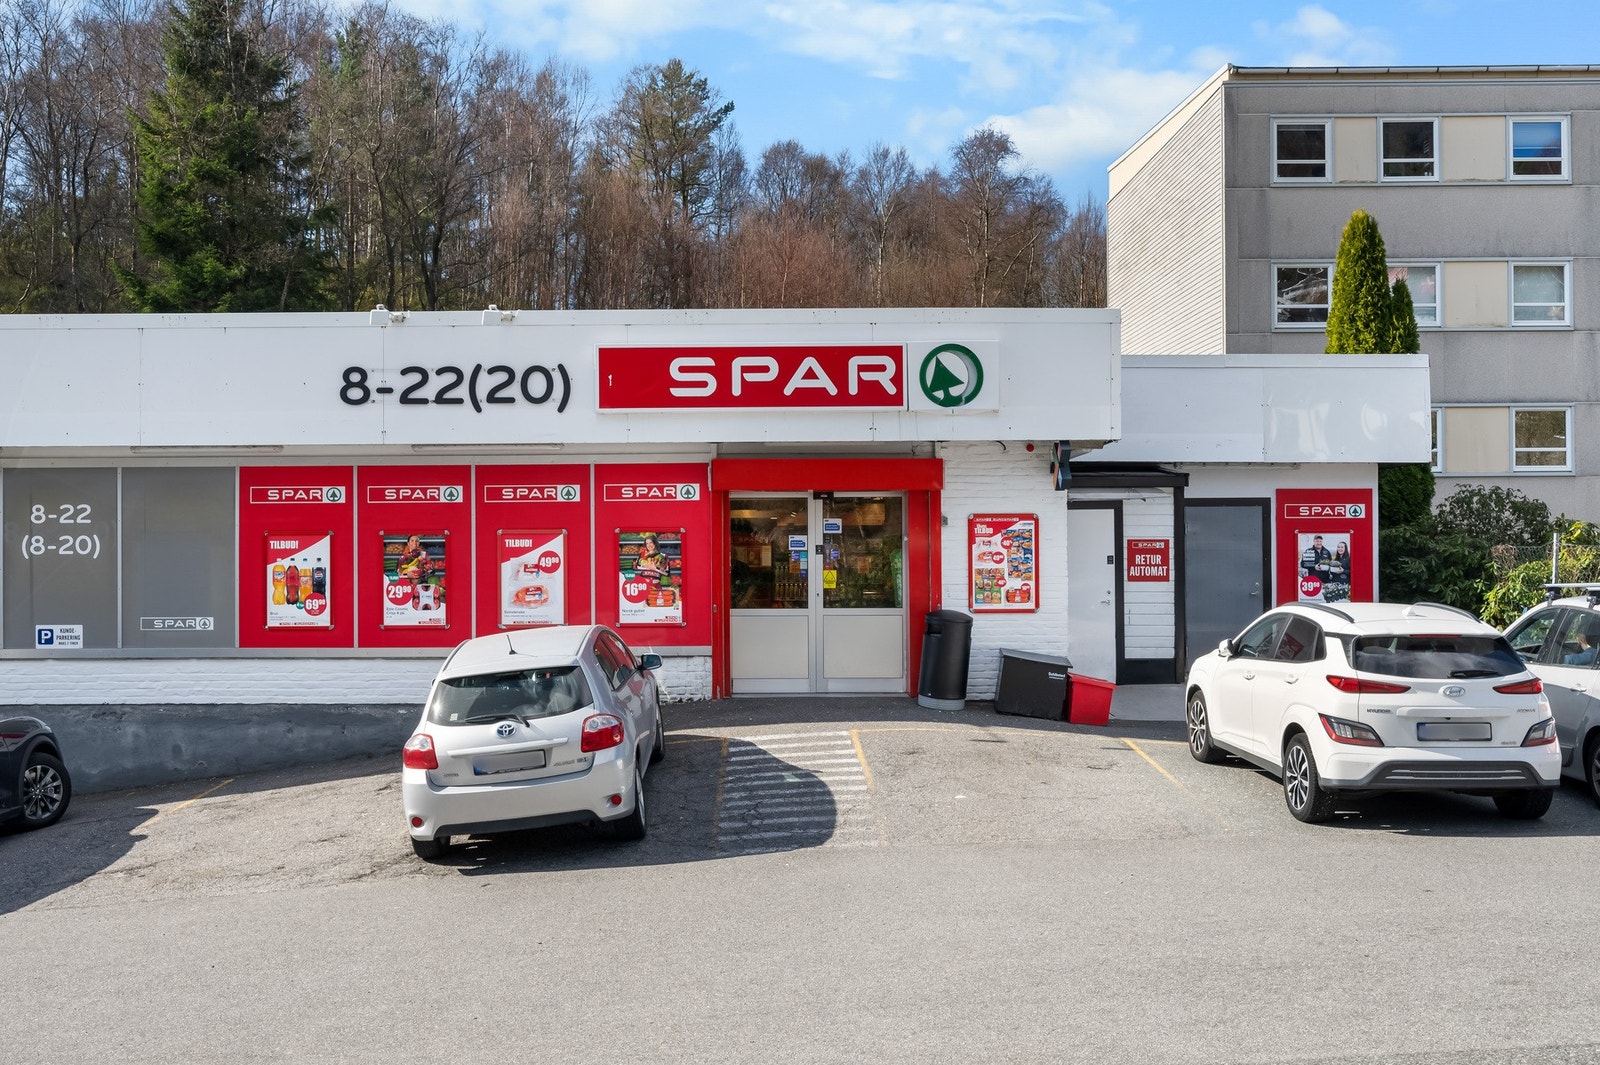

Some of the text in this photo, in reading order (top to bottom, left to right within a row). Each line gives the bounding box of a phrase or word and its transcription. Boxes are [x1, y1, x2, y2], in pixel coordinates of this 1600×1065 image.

[668, 355, 897, 397] SPAR
[339, 363, 571, 413] 8-22(20)
[267, 490, 322, 500] SPAR
[385, 489, 439, 500] SPAR
[502, 488, 556, 498] SPAR
[621, 487, 676, 498] SPAR
[30, 503, 92, 524] 8-22
[1299, 506, 1346, 516] SPAR
[21, 534, 101, 559] (8-20)
[269, 540, 299, 549] TILBUD!
[505, 539, 533, 548] TILBUD!
[1135, 554, 1162, 565] RETUR
[1129, 566, 1168, 577] AUTOMAT
[154, 619, 196, 628] SPAR
[41, 630, 52, 643] P
